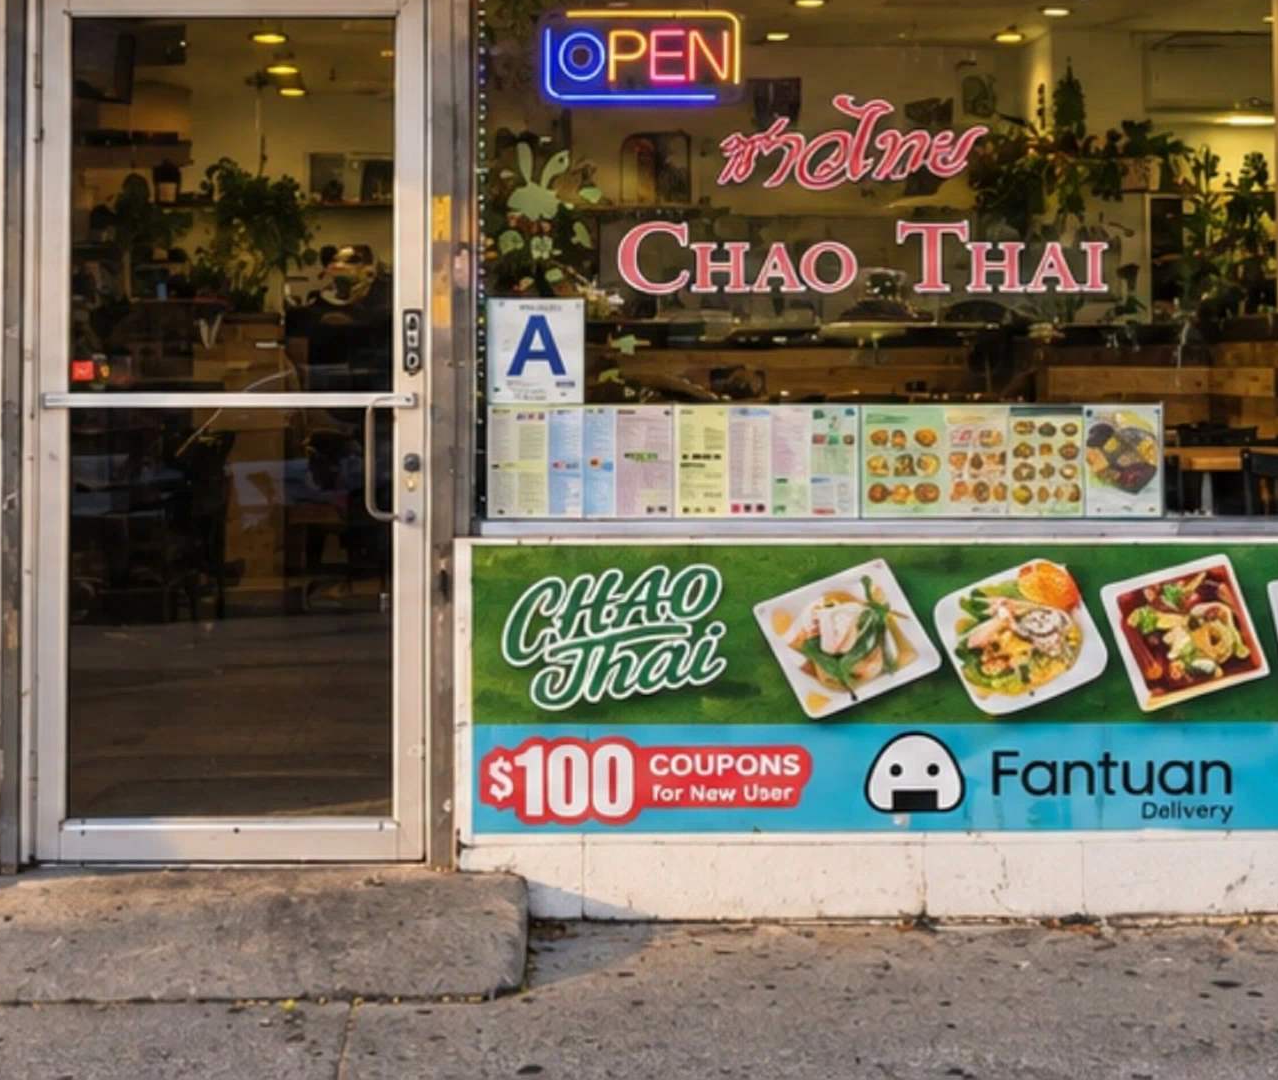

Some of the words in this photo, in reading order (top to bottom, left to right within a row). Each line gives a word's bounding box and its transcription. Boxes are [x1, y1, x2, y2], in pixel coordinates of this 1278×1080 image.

[557, 28, 731, 83] OPEN
[506, 315, 566, 376] A
[502, 564, 724, 667] CHAO
[530, 620, 728, 710] Thai
[488, 743, 635, 817] $100
[649, 753, 801, 777] COUPONS
[651, 783, 684, 802] for
[690, 784, 736, 802] New
[743, 783, 794, 802] User
[991, 750, 1233, 797] Fantuan
[1141, 801, 1234, 823] Delivery
